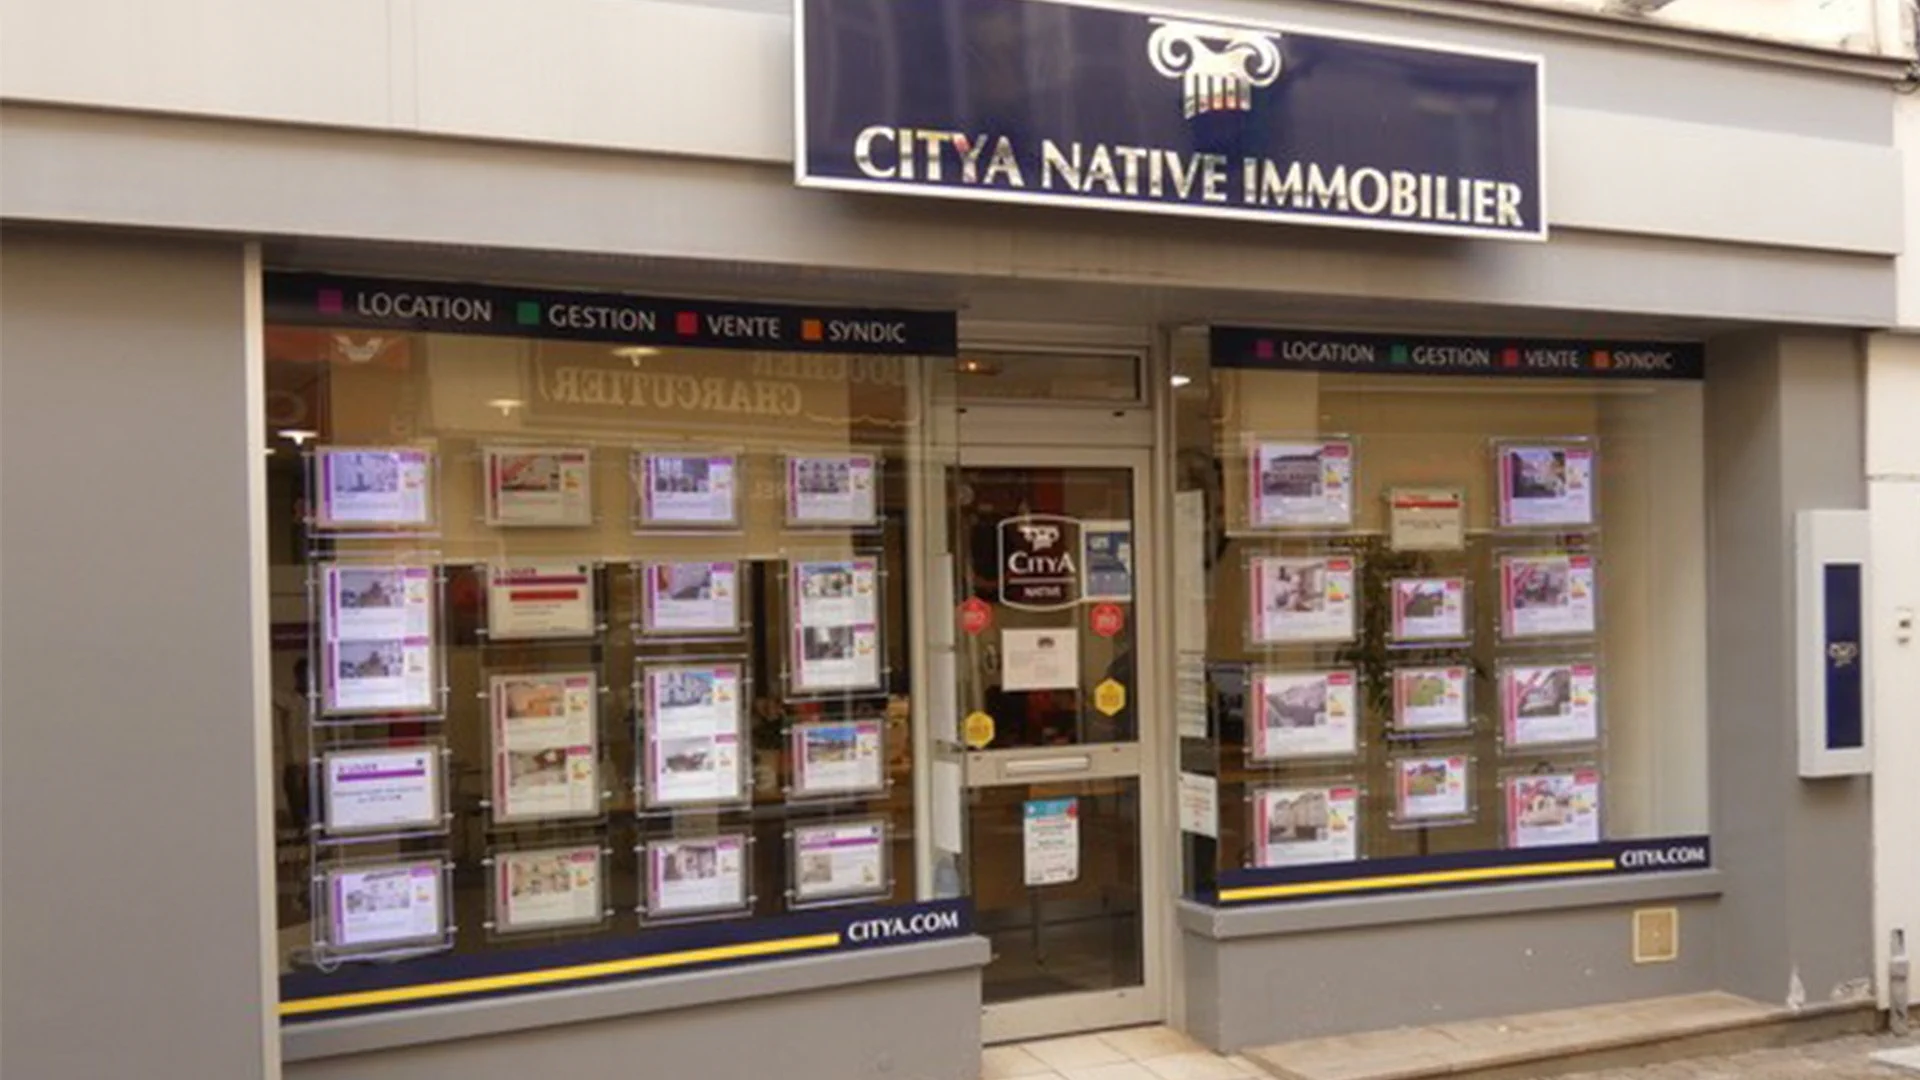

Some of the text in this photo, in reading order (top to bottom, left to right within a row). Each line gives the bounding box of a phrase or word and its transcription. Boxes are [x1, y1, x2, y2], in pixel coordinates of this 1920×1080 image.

[854, 126, 1525, 227] CITYA NATIVE IMMOBILIER
[357, 291, 907, 344] LOCATION GESTION VENTE SYNDIC
[1282, 340, 1674, 370] LOCATION GESTION VENTE SYNDIC
[1023, 586, 1061, 598] NATIVE
[1621, 847, 1705, 867] CITYA.COM
[848, 912, 959, 942] CITYA.COM
